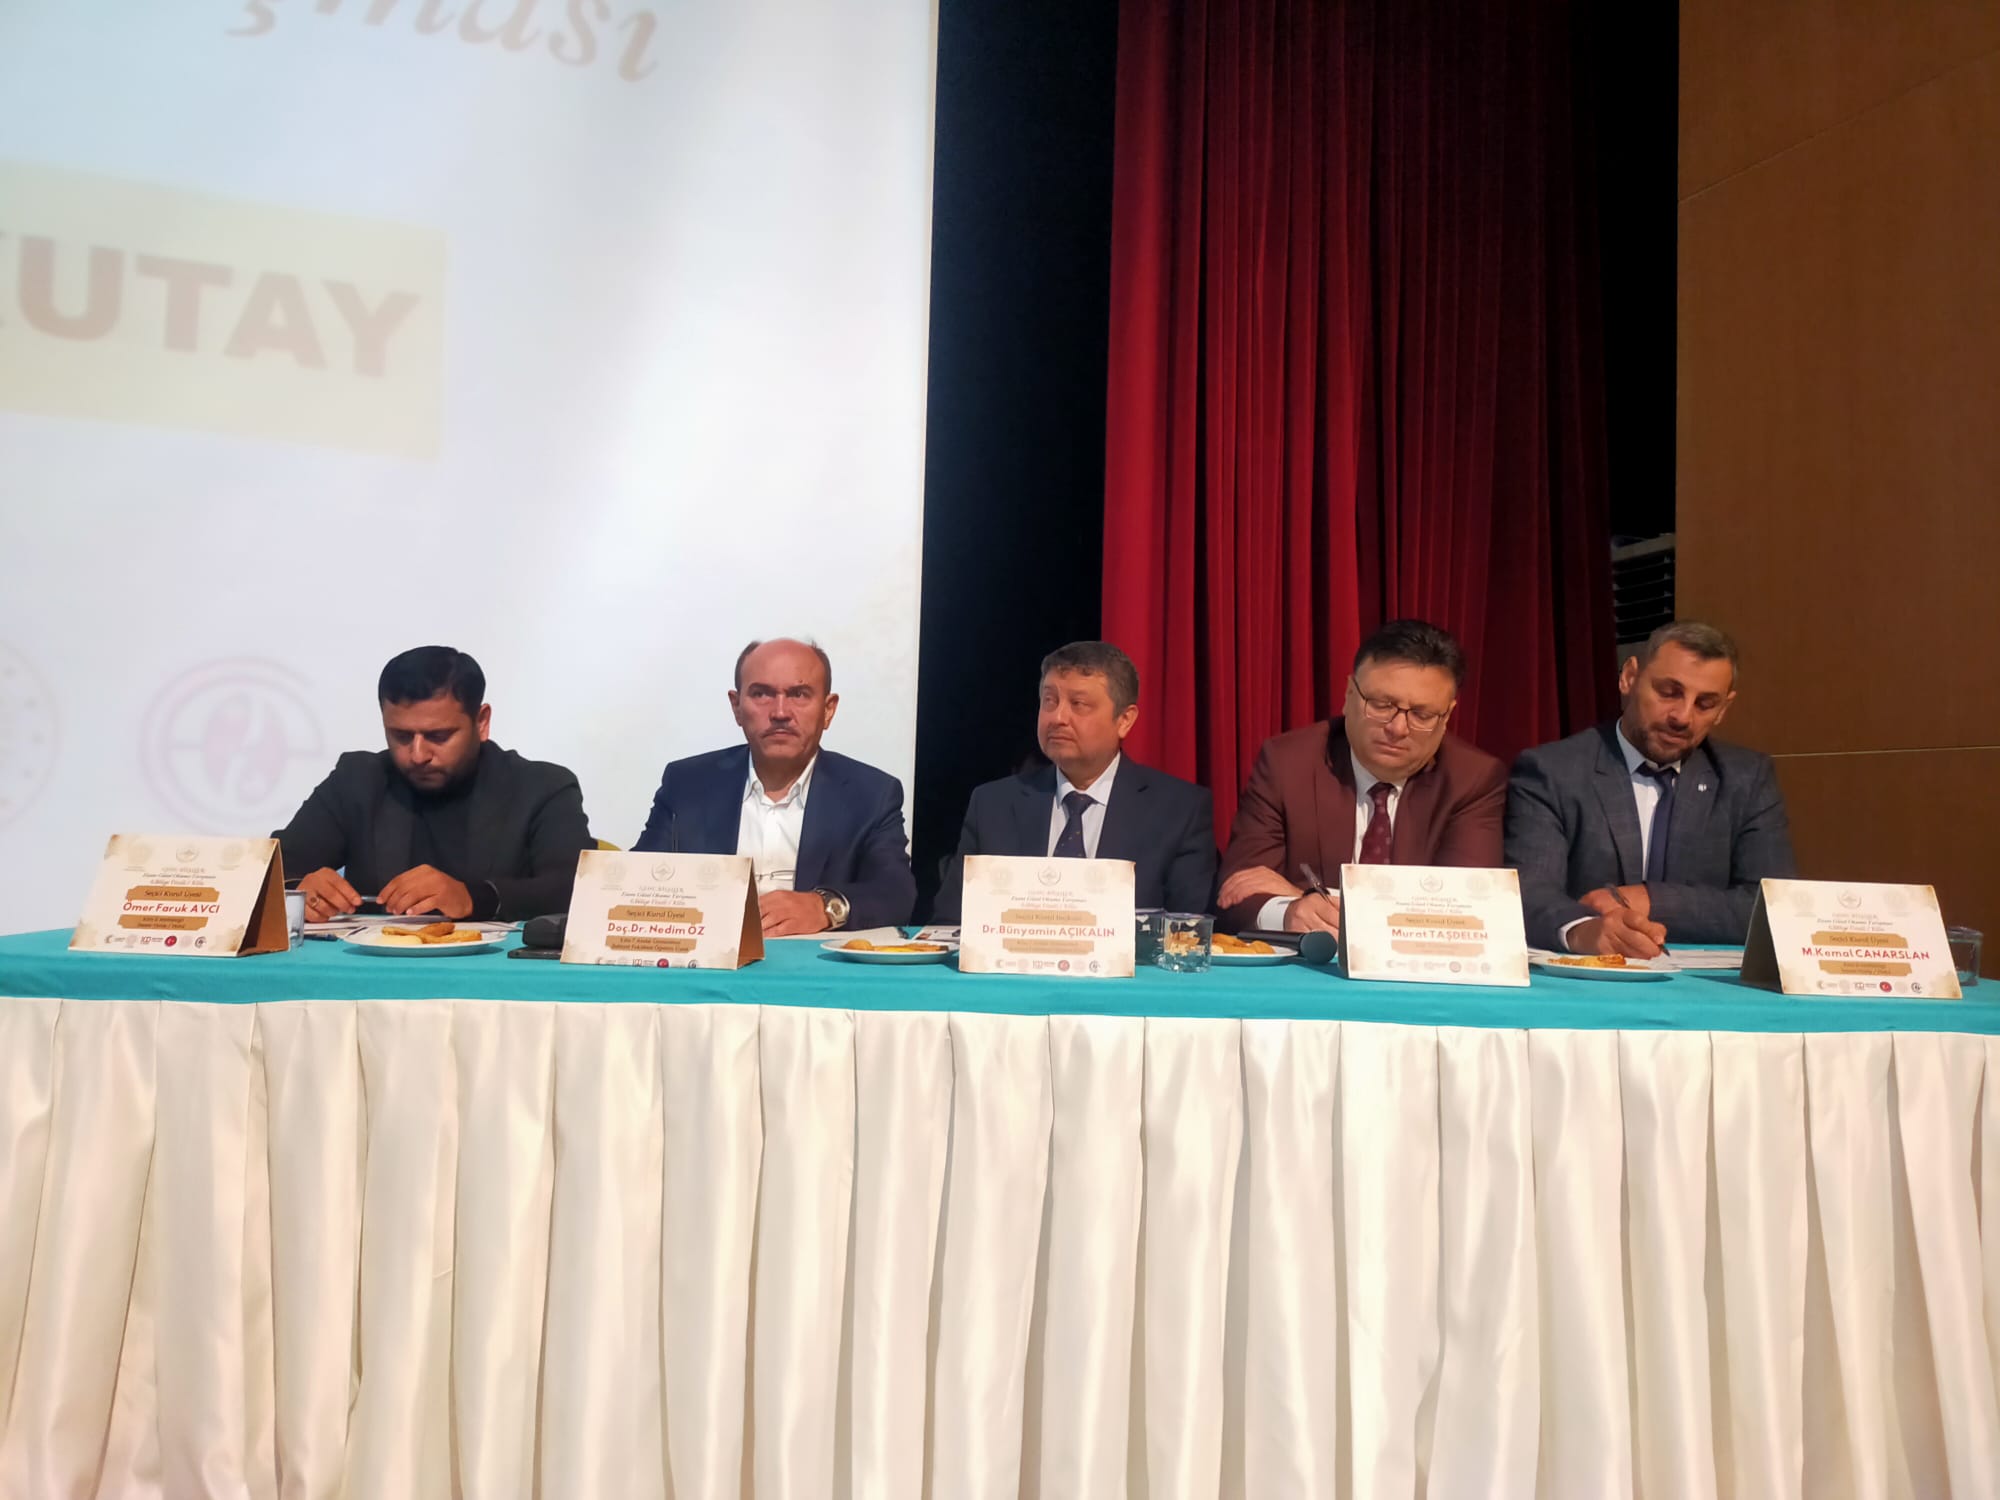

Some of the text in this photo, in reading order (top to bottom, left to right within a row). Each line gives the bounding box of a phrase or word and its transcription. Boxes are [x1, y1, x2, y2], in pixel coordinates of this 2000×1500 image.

[0, 231, 424, 381] UTAY
[122, 899, 221, 914] Ömer Faruk AVCI
[649, 924, 686, 935] Nedim
[1059, 927, 1115, 939] AÇIKALIN
[1391, 928, 1489, 942] Murat TAŞDELEN
[1855, 949, 1931, 960] CANARSLAN
